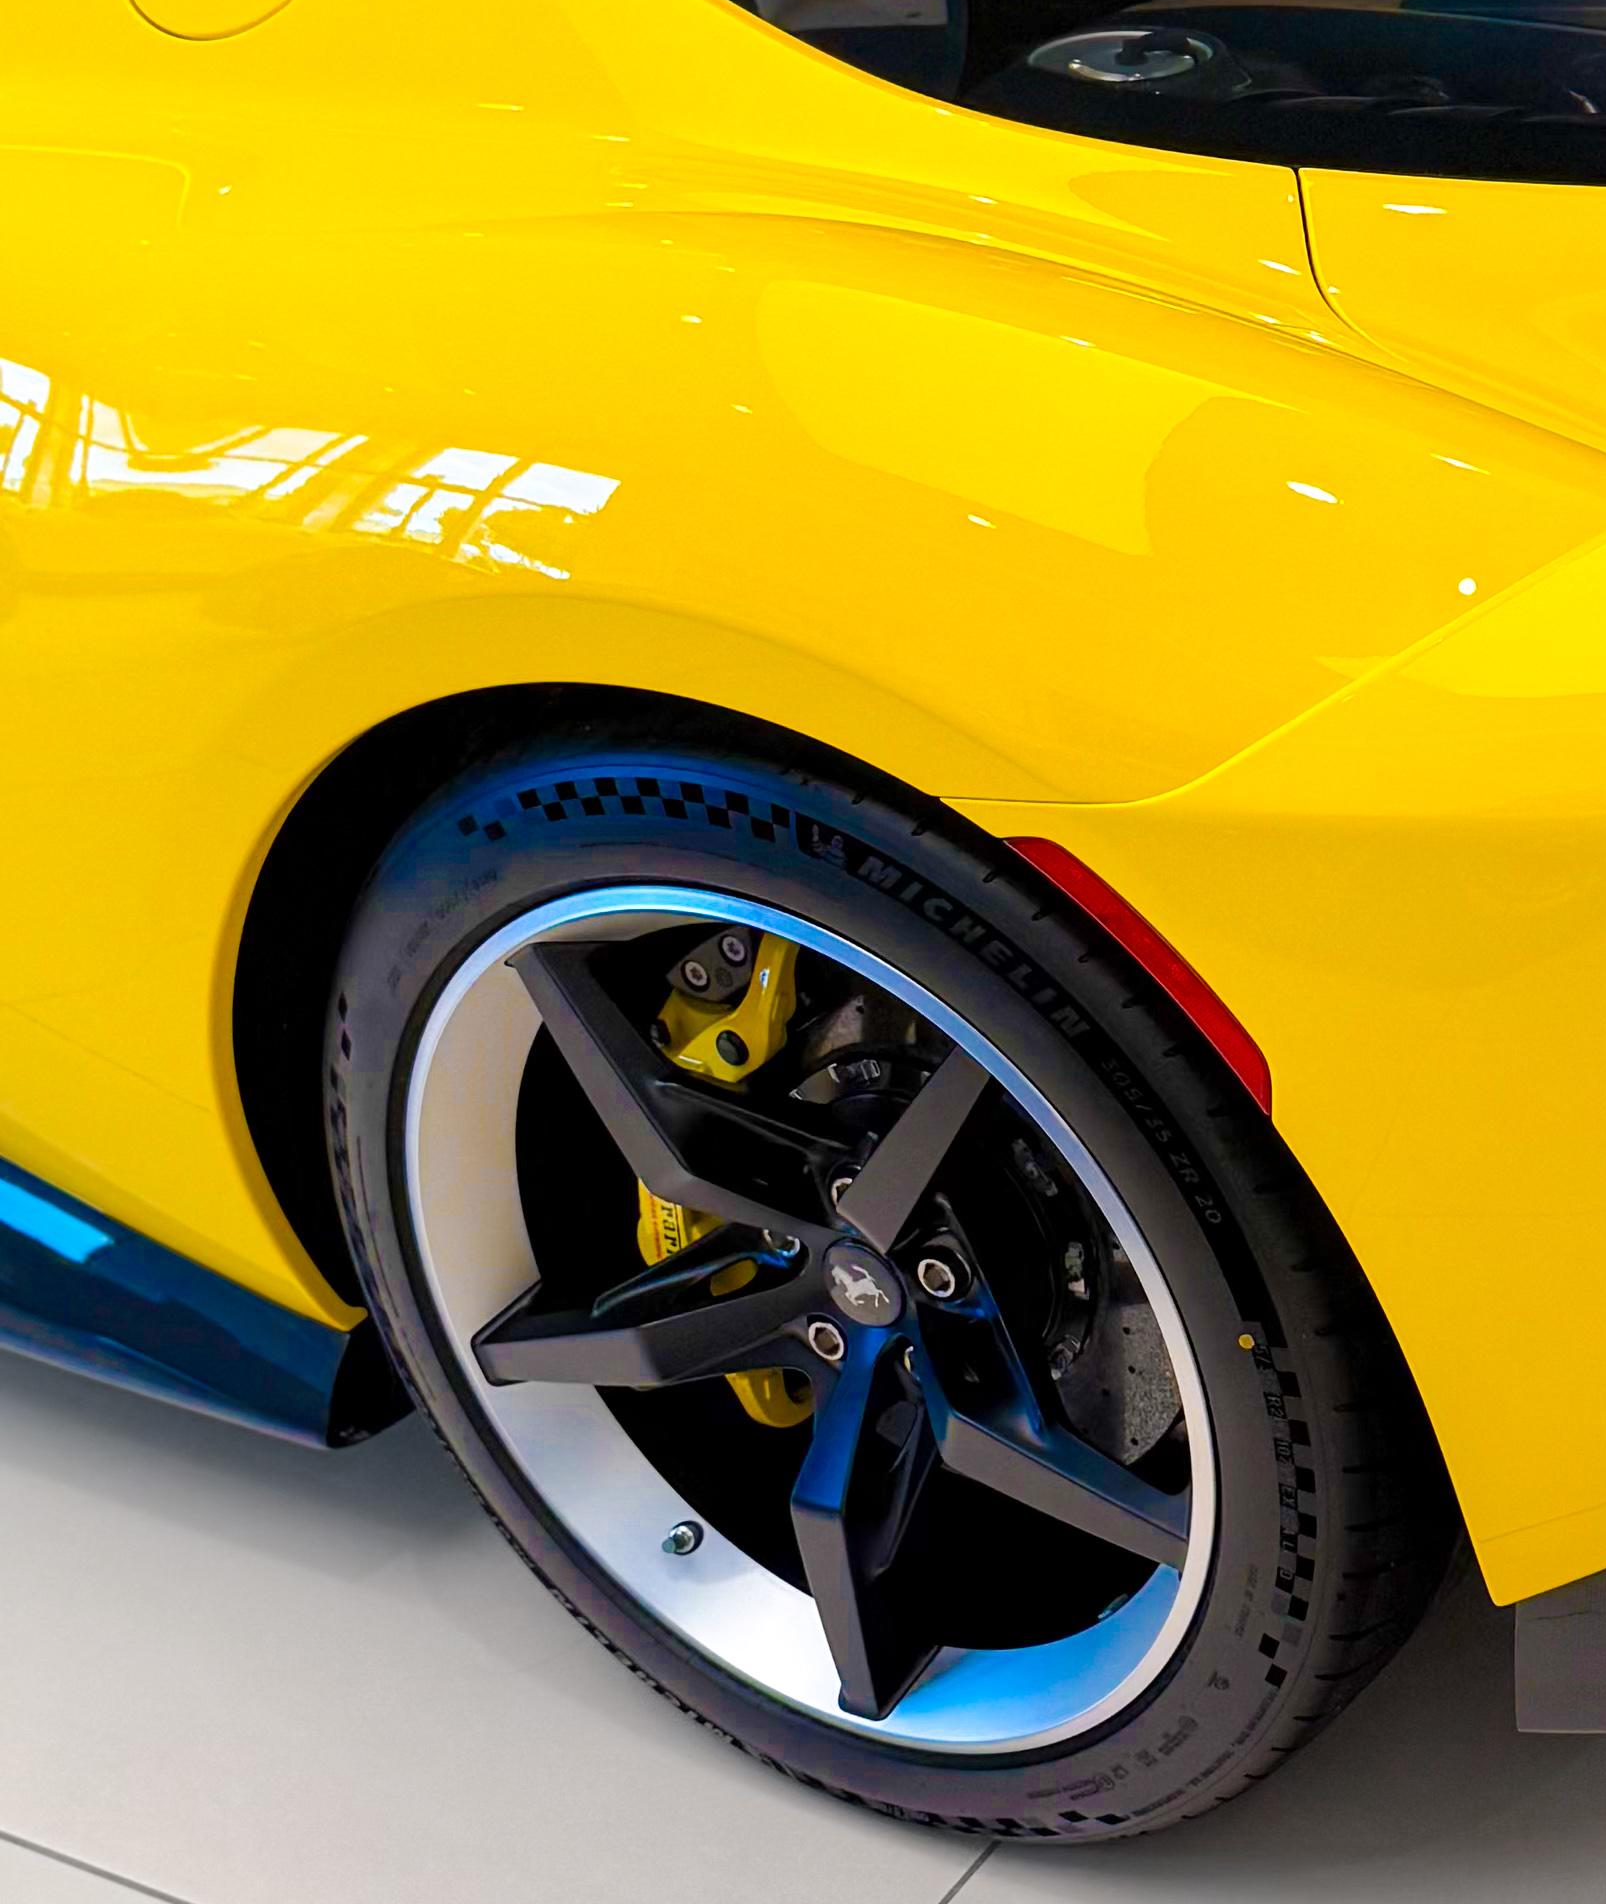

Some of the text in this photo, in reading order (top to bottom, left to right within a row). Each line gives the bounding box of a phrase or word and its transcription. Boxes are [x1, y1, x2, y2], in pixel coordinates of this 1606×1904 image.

[857, 855, 1092, 1039] MICHELIN
[1168, 1146, 1201, 1186] ZR
[1194, 1194, 1222, 1226] 20
